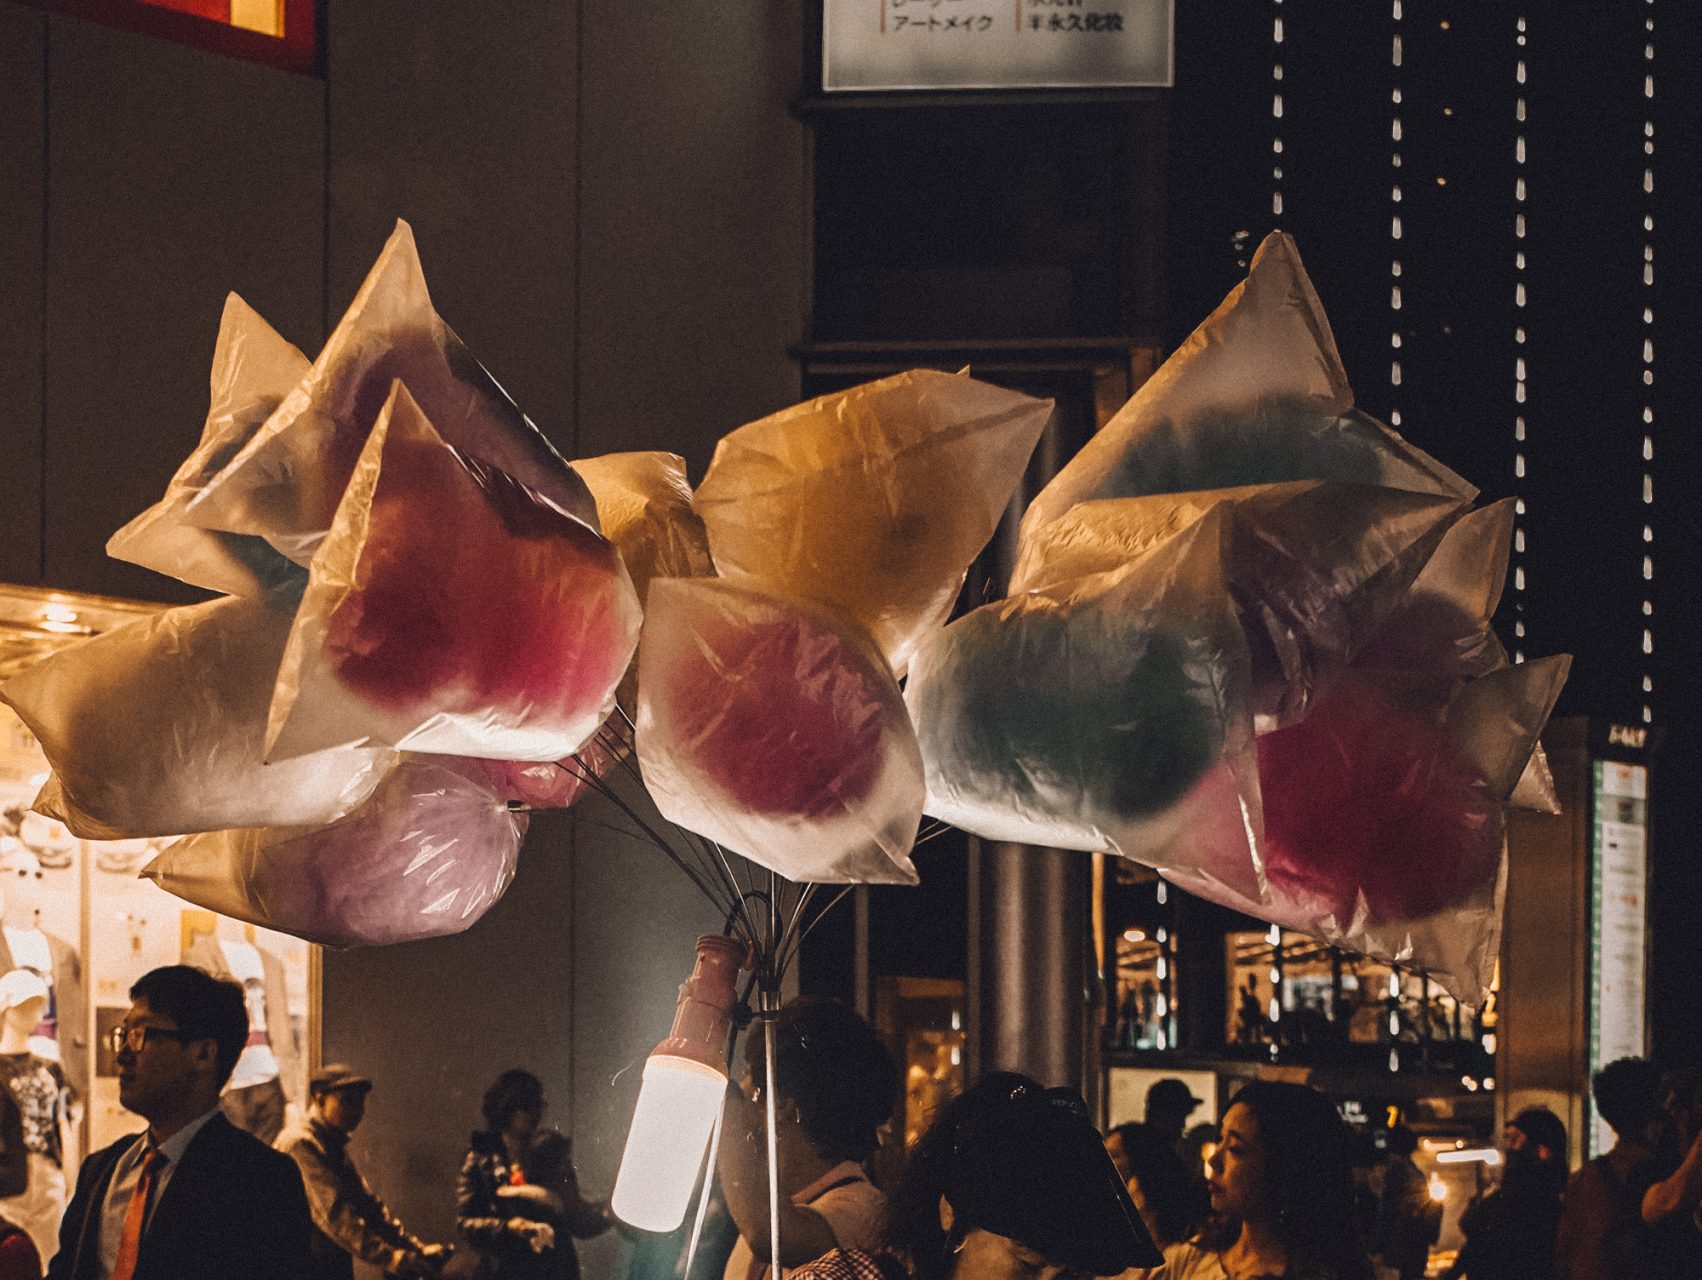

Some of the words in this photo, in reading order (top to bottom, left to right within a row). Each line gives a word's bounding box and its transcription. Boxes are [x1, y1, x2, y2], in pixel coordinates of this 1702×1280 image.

[893, 15, 993, 32] アートメイク
